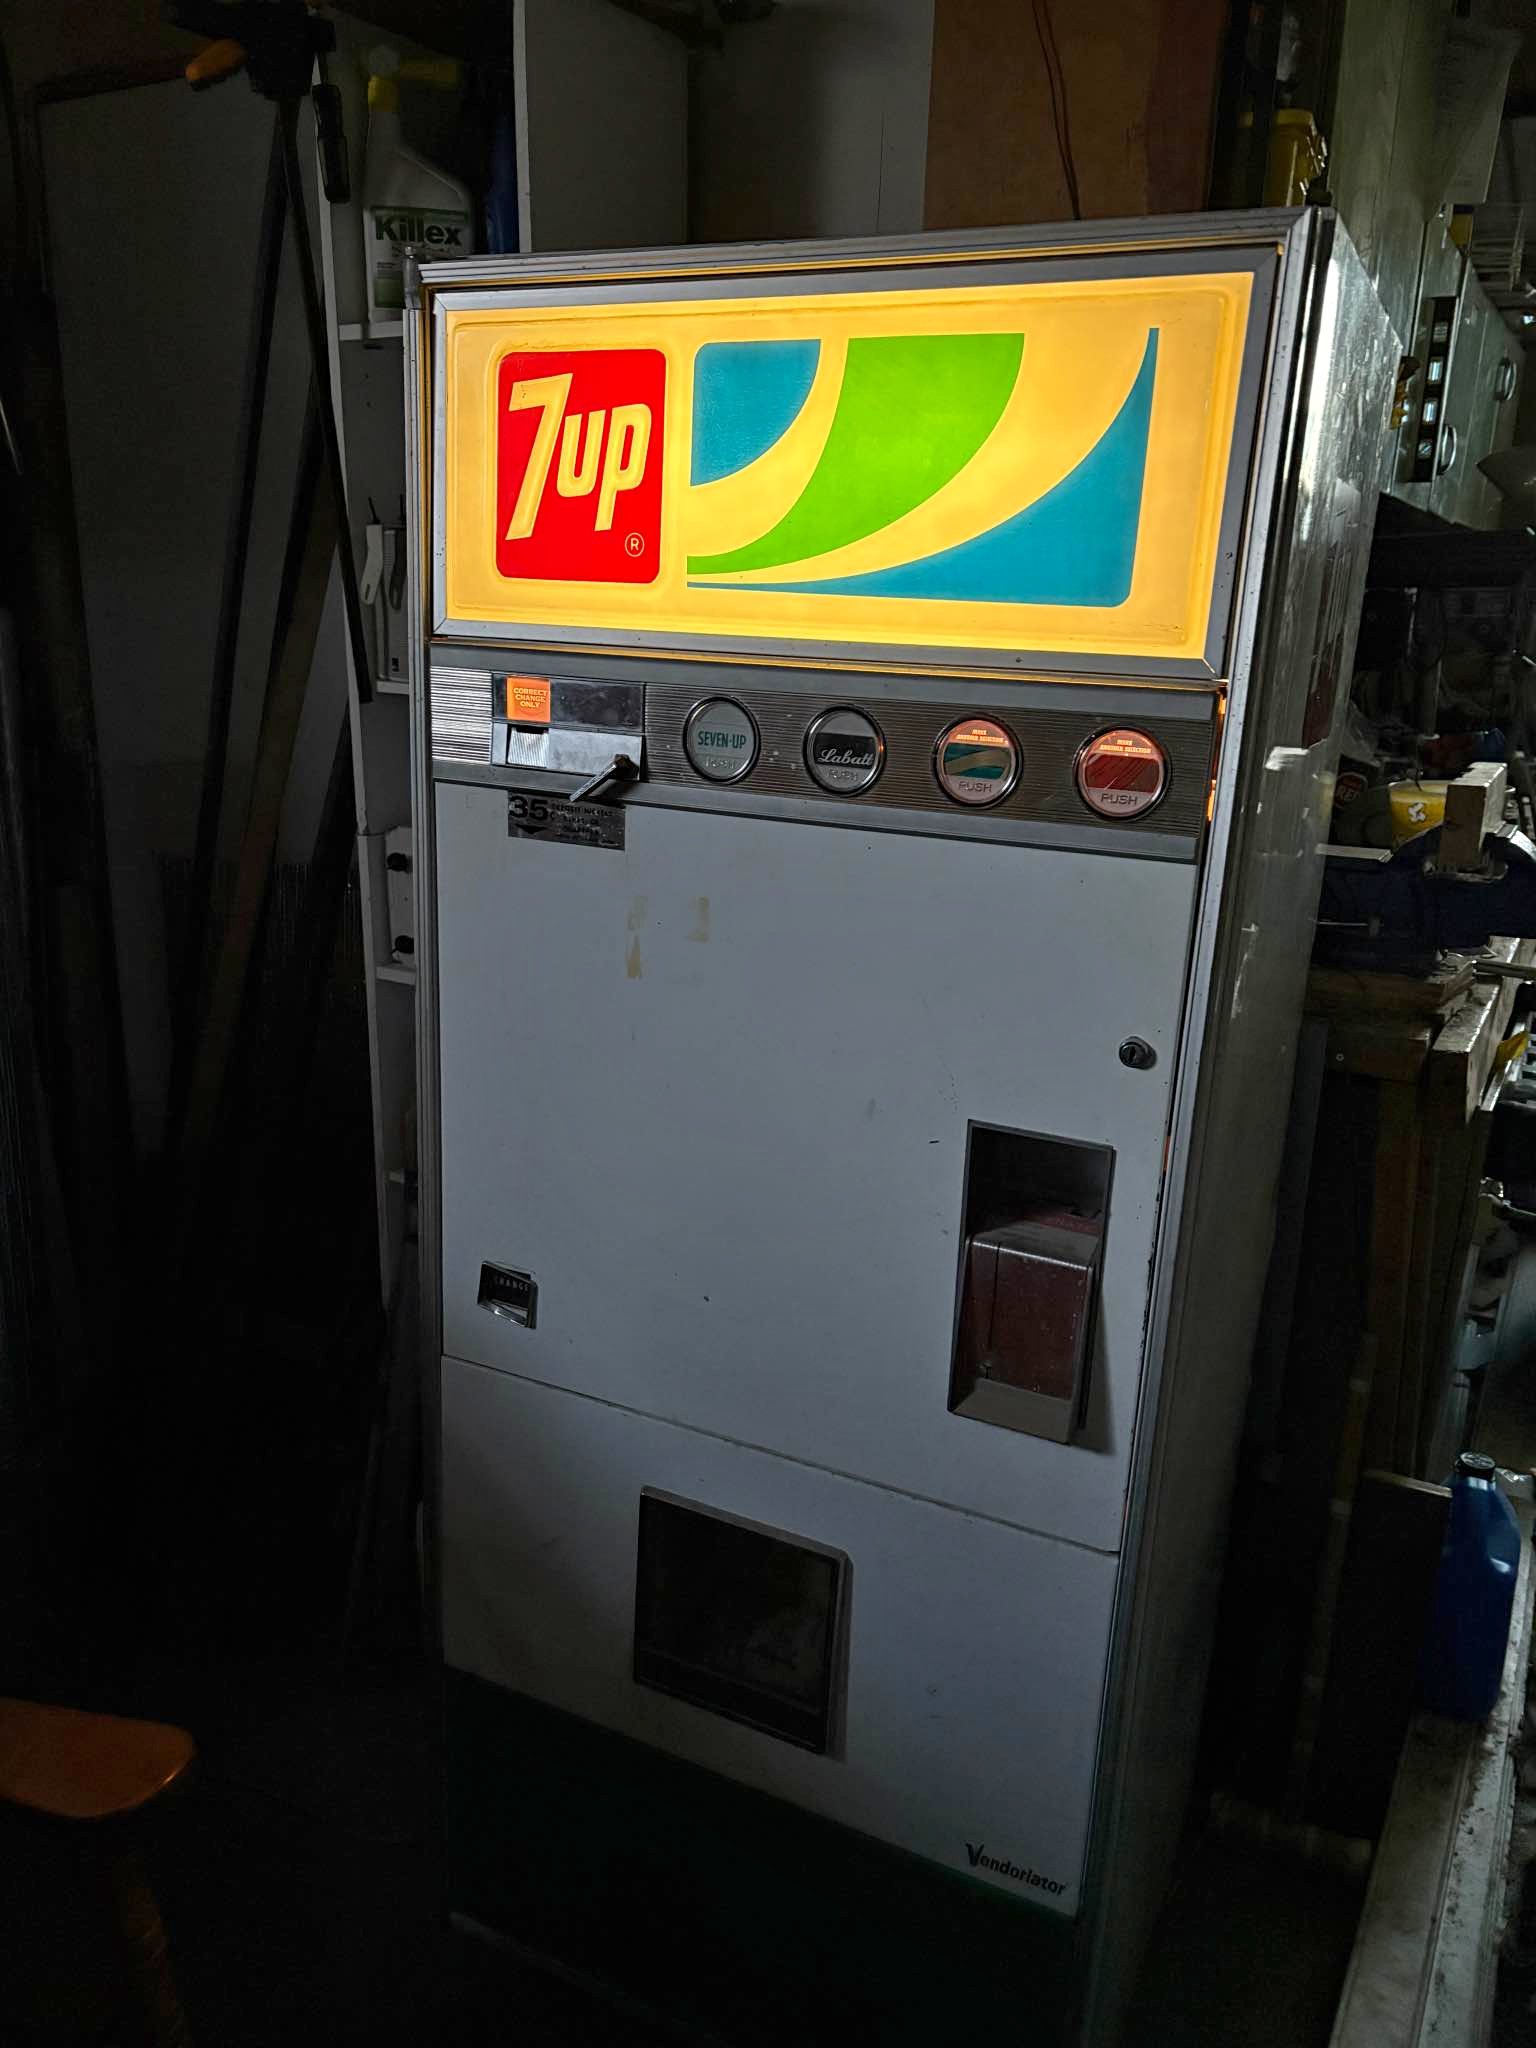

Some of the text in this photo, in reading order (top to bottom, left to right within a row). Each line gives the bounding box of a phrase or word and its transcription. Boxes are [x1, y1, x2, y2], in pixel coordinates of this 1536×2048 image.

[375, 215, 462, 246] Killex
[513, 687, 548, 697] CORRECT
[515, 693, 547, 704] CHANGE
[520, 700, 541, 708] ONLY
[816, 747, 875, 767] Labatt
[958, 780, 993, 793] PUSH
[1100, 792, 1138, 806] PUSH
